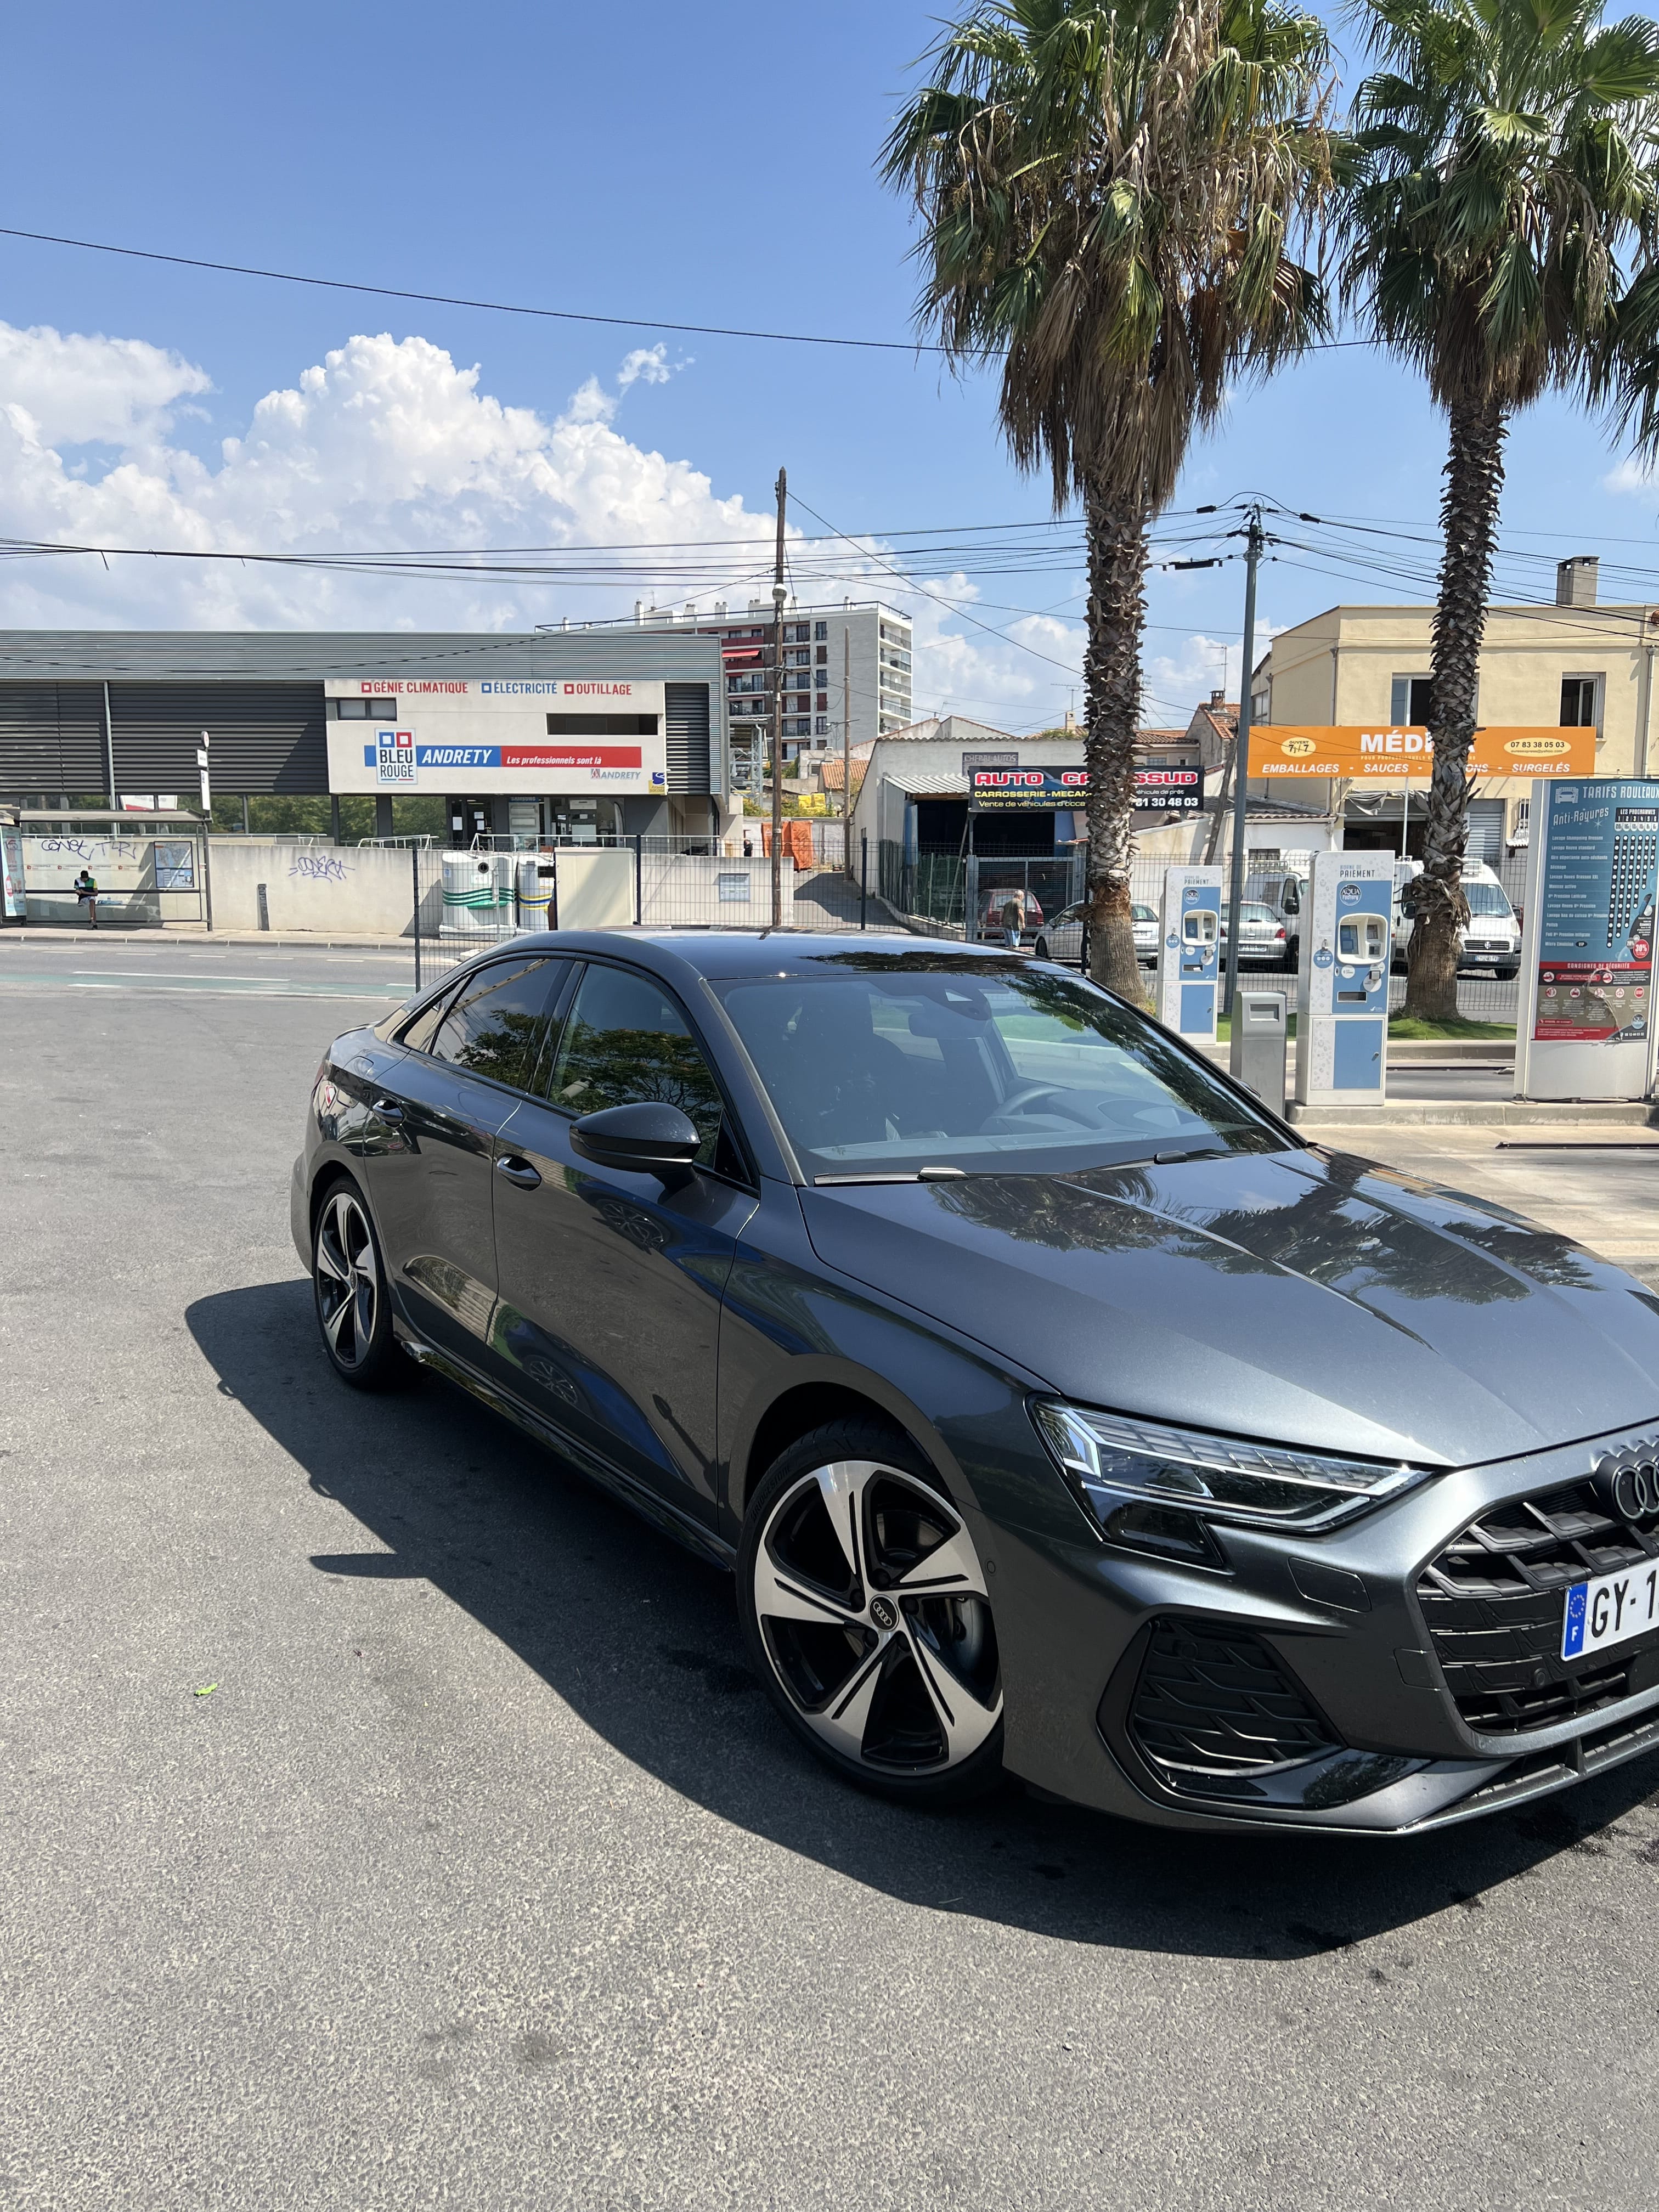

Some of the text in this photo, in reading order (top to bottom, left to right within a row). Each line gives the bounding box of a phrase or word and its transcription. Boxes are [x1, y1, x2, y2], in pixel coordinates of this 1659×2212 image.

[374, 680, 469, 694] GÉNIE CLIMATIQUE
[494, 681, 557, 694] ÉLECTRICITÉ
[577, 684, 633, 695] OUTILLAGE
[380, 749, 413, 764] BLEU
[421, 749, 493, 764] ANDRETY
[506, 756, 520, 764] Les
[521, 756, 575, 765] professionnels
[594, 756, 602, 764] là
[381, 765, 414, 777] ROUGE
[1262, 764, 1340, 773] EMBALLAGES
[1363, 763, 1409, 773] SAUCES
[1511, 761, 1571, 773] SURGELÉS
[601, 771, 641, 780] ANDRETY
[974, 772, 1044, 786] AUTO
[1583, 786, 1617, 799] TARIFS
[1151, 798, 1166, 807] 30
[1167, 798, 1182, 807] 48
[1184, 798, 1198, 807] 03
[1553, 807, 1610, 826] Anti-Rayures
[1340, 870, 1375, 878] PAIEMENT
[1635, 944, 1647, 952] 30%
[1571, 1626, 1579, 1641] F
